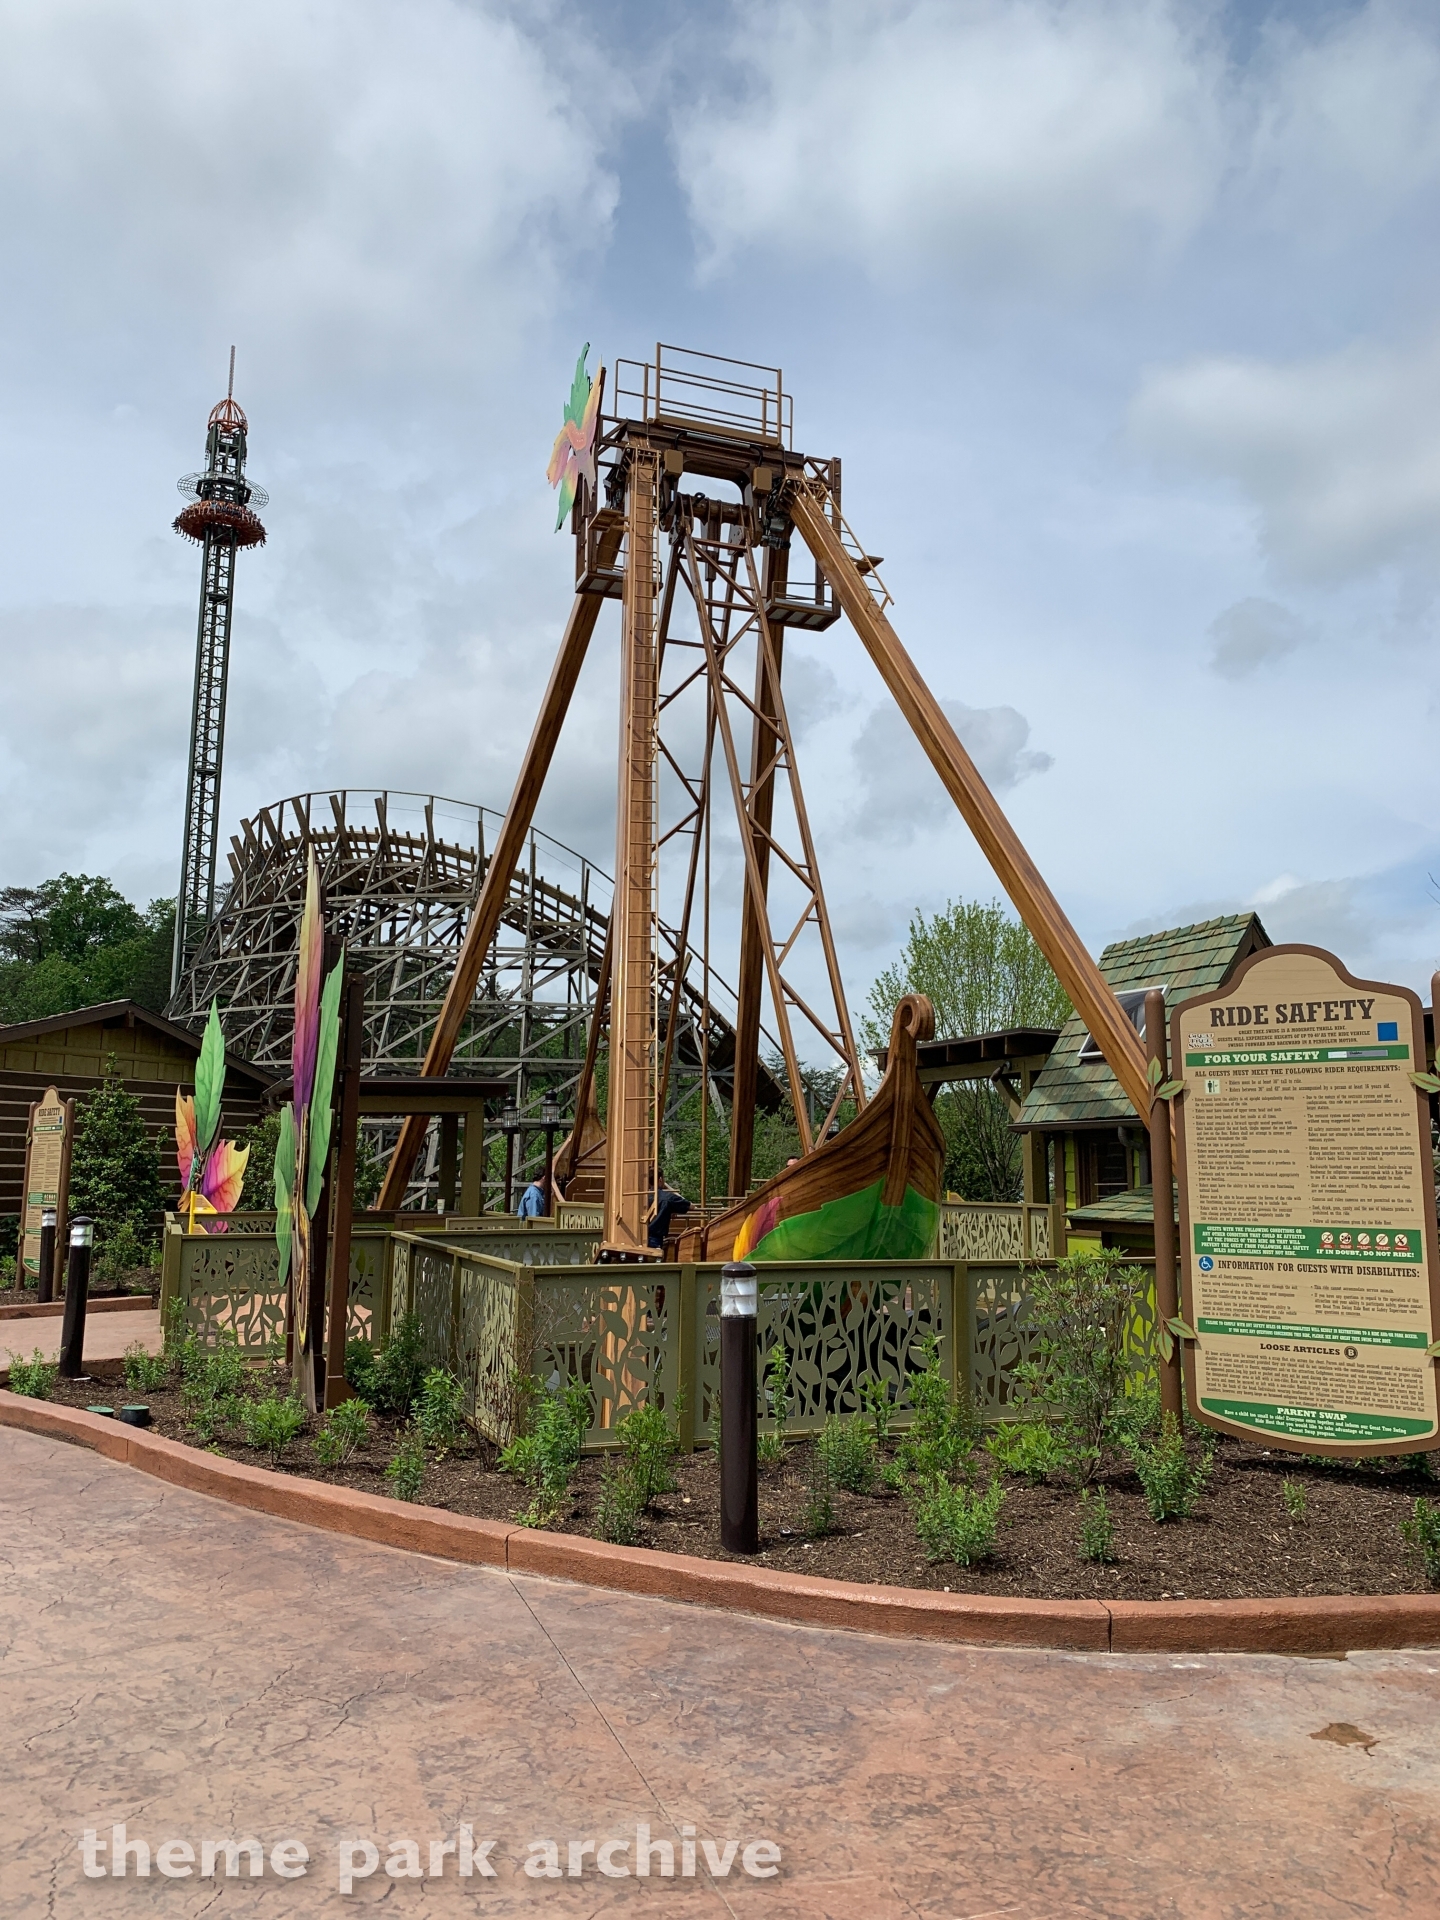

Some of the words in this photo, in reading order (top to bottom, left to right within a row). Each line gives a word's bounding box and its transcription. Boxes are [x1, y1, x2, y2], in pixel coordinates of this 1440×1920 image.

[1210, 1005, 1268, 1028] RIDE
[1276, 999, 1375, 1024] SAFETY
[1204, 1055, 1231, 1064] FOR
[1232, 1054, 1267, 1063] YOUR
[1270, 1051, 1320, 1061] SAFETY
[1218, 1260, 1274, 1271] INFORMATION
[1278, 1263, 1294, 1272] FOR
[1297, 1264, 1327, 1274] GUESTS
[1330, 1265, 1353, 1274] WITH
[1357, 1266, 1420, 1277] DISABILITIES:
[1260, 1343, 1290, 1351] LOOSE
[1293, 1346, 1340, 1355] ARTICLES
[1276, 1408, 1316, 1418] PARENT
[1319, 1412, 1347, 1420] SWAP
[1335, 1426, 1357, 1434] advantage
